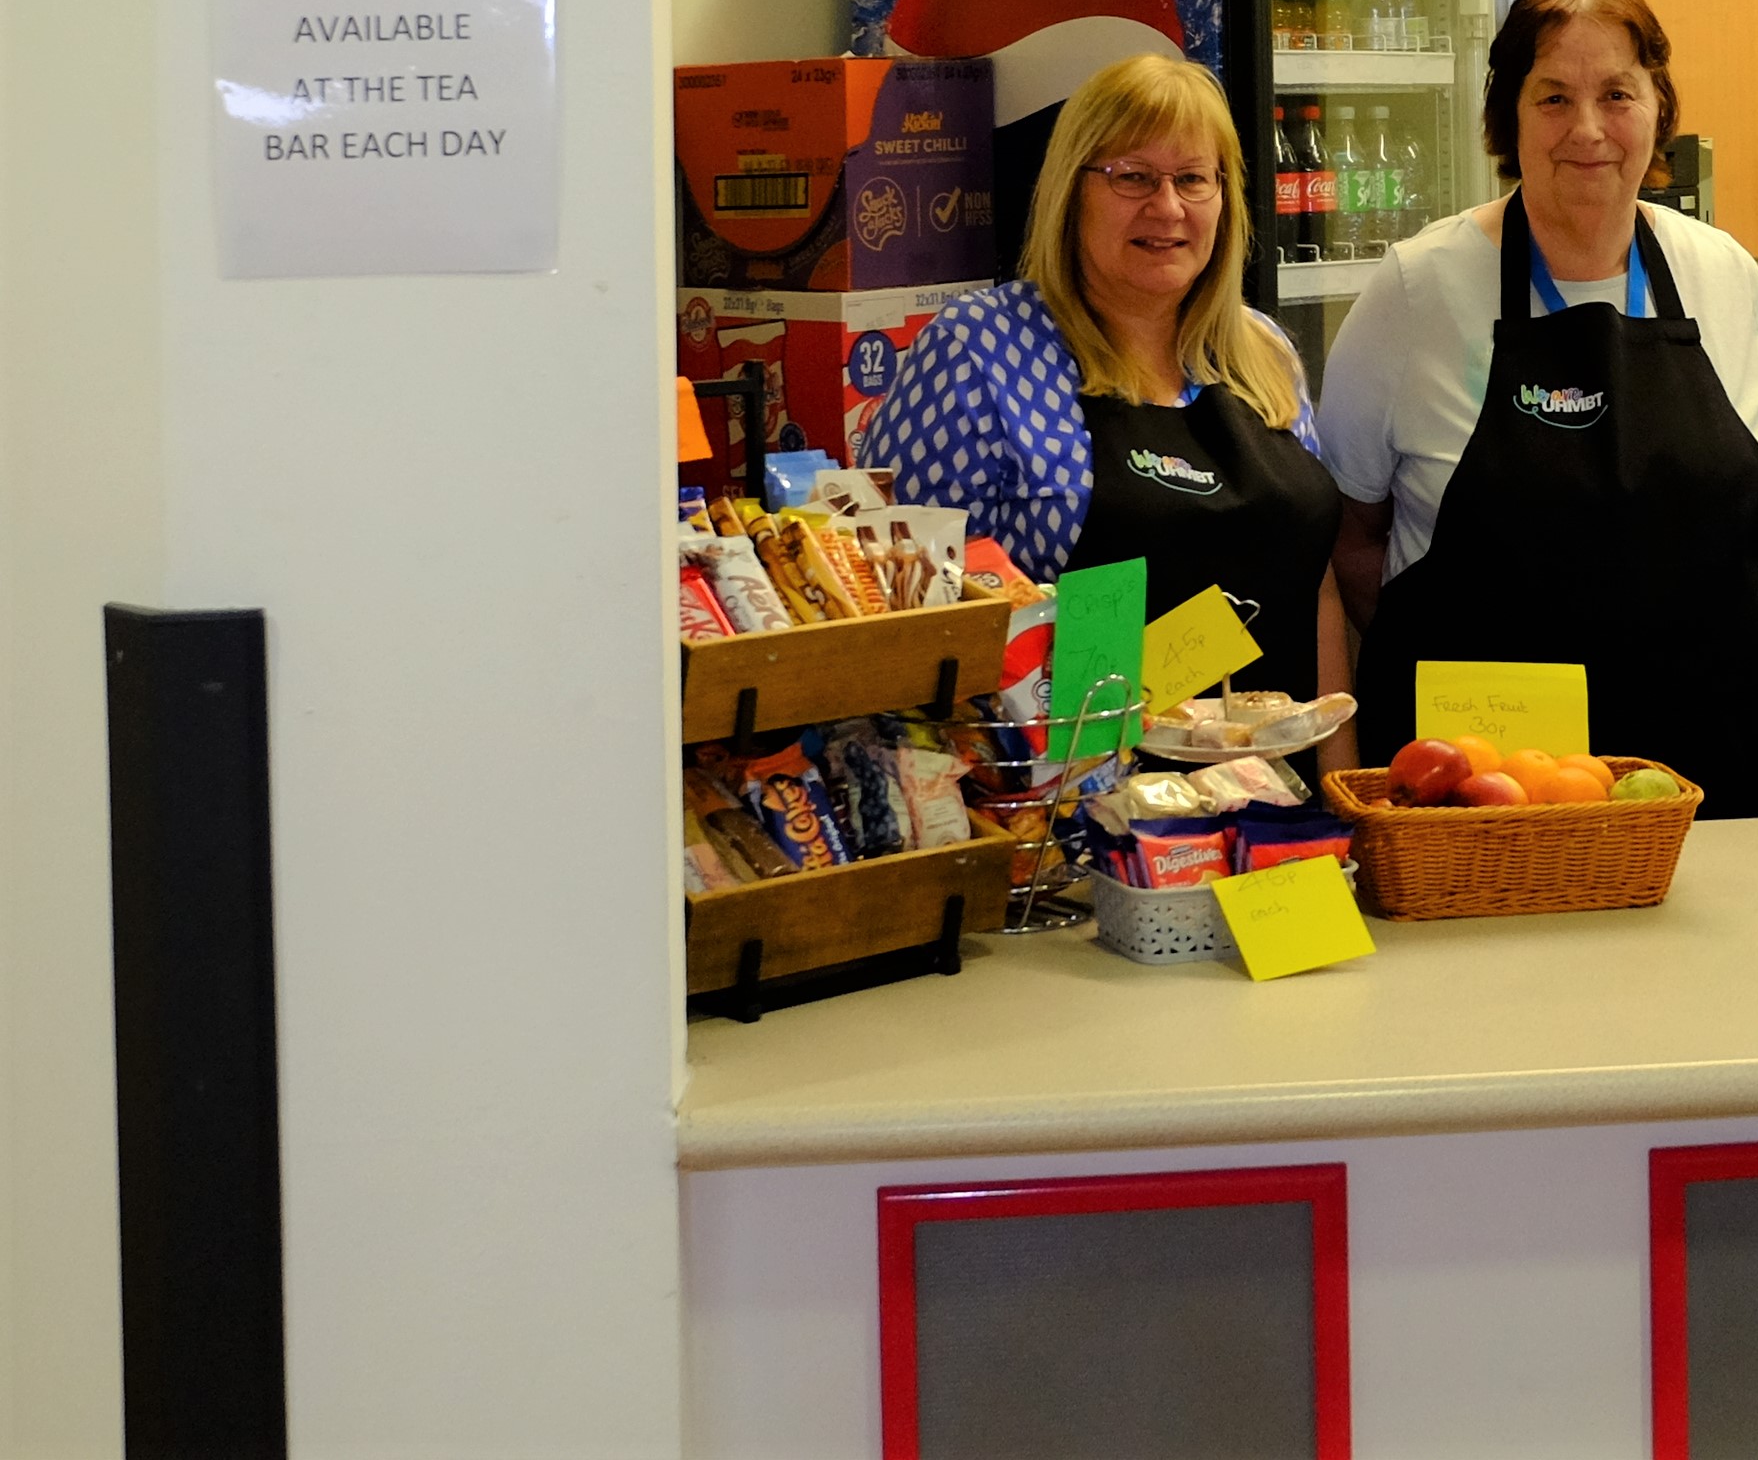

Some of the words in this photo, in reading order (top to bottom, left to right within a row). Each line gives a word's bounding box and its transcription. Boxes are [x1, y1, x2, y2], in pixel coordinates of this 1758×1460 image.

[294, 14, 472, 42] AVAILABLE
[292, 78, 332, 105] AT
[343, 77, 405, 103] THE
[416, 75, 479, 102] TEA
[265, 135, 329, 161] BAR
[342, 132, 428, 159] EACH
[441, 130, 507, 157] DAY
[875, 141, 921, 155] SWEET
[923, 137, 967, 152] CHILLI
[964, 192, 991, 209] NON
[859, 341, 884, 374] 32
[863, 374, 883, 387] BAGS
[1521, 384, 1550, 404] We
[1542, 392, 1604, 412] UHMBT
[1162, 627, 1205, 668] 45p
[1165, 667, 1205, 696] each
[1432, 696, 1479, 713] Fresh
[1487, 695, 1528, 713] Fruit
[1469, 716, 1506, 737] 30p
[1154, 848, 1222, 873] Digestives
